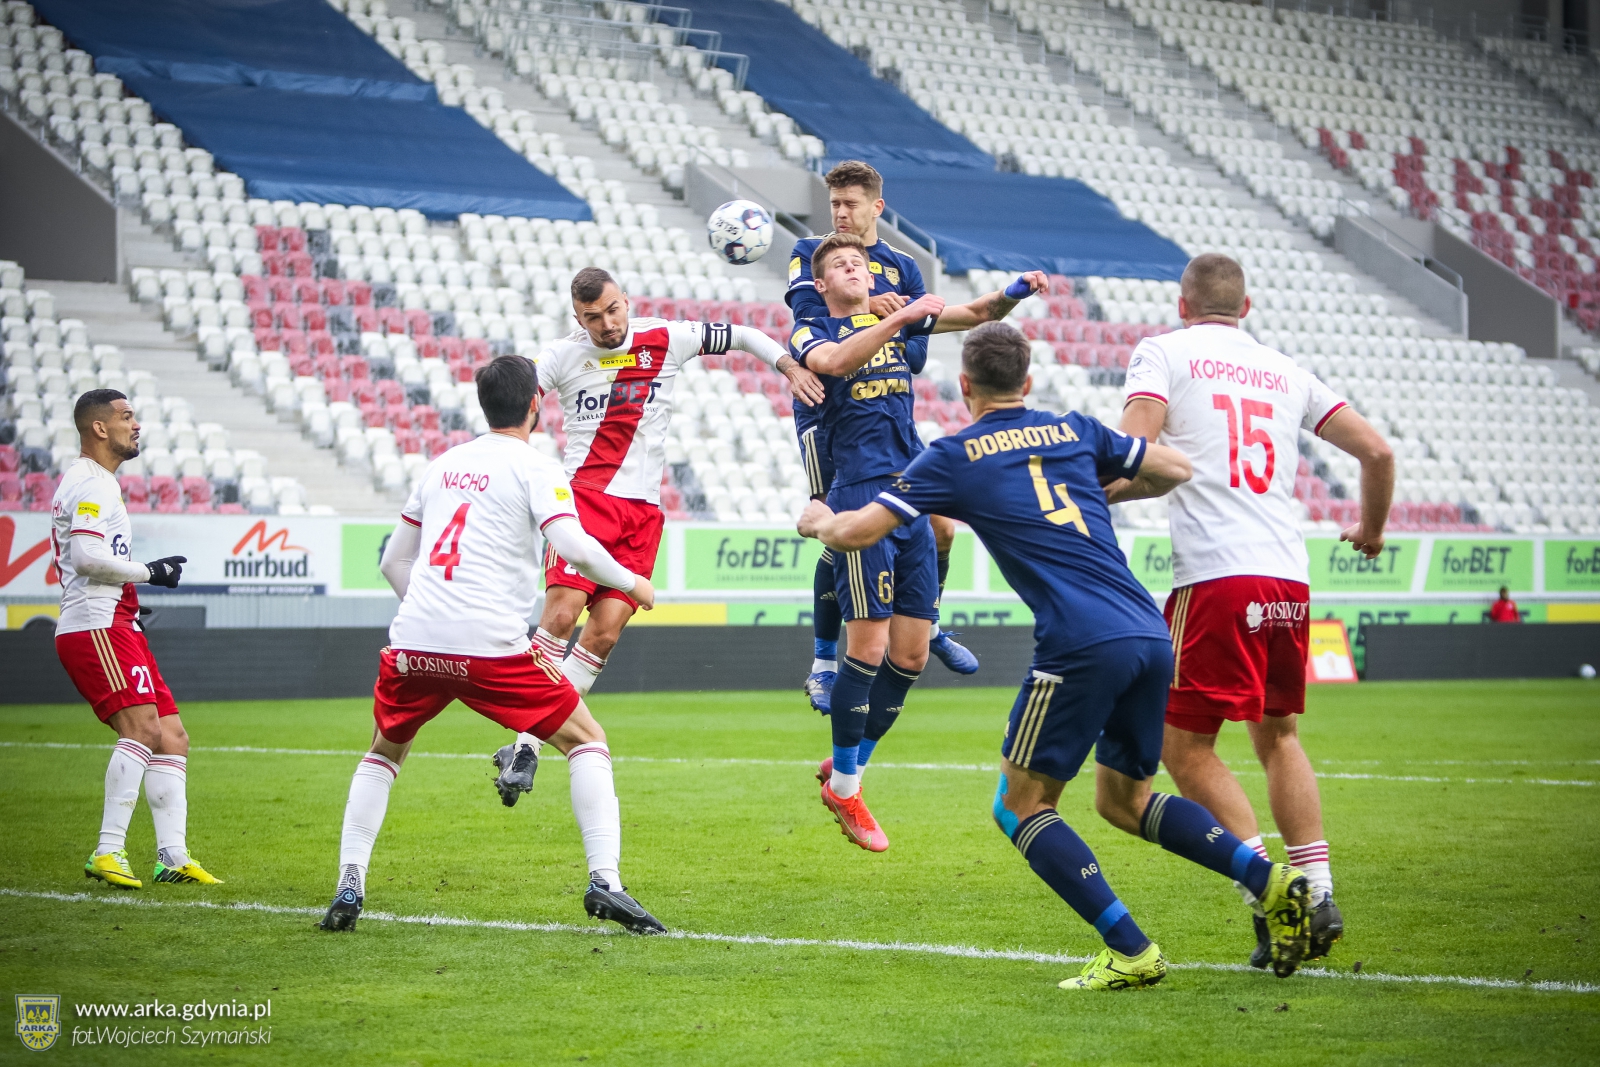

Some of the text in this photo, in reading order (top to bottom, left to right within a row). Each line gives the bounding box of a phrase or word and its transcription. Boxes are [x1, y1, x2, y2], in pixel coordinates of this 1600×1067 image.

[1189, 358, 1289, 394] KOPROWSKI
[575, 381, 662, 414] forBET
[963, 421, 1080, 463] DOBROTKA
[1211, 393, 1275, 495] 15
[440, 471, 490, 492] NACHO
[1027, 454, 1092, 539] 4
[429, 502, 471, 581] 4
[716, 537, 807, 569] forBET
[224, 551, 308, 578] mirbud
[1442, 546, 1512, 574] forBET
[1566, 546, 1600, 574] forB
[131, 665, 155, 694] 21
[408, 655, 468, 677] COSINUS
[1206, 826, 1225, 843] AG
[1081, 862, 1098, 879] AG
